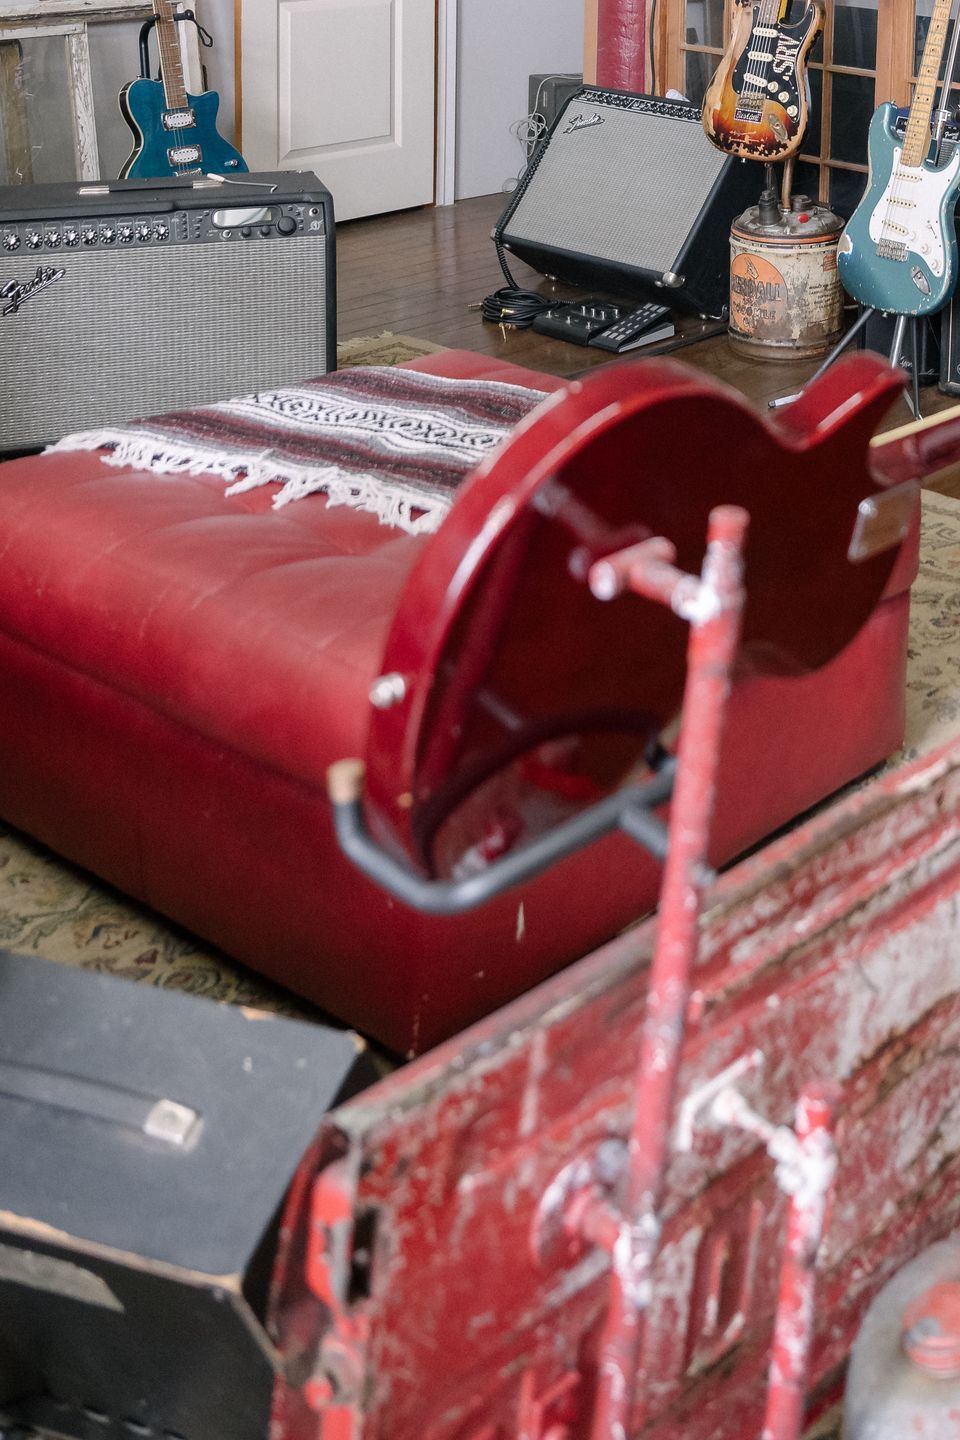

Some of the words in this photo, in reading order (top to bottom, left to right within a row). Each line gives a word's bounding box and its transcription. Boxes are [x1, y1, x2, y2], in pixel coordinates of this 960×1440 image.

[563, 113, 605, 135] Fender
[0, 266, 66, 317] Fender
[732, 274, 782, 302] ENDALL
